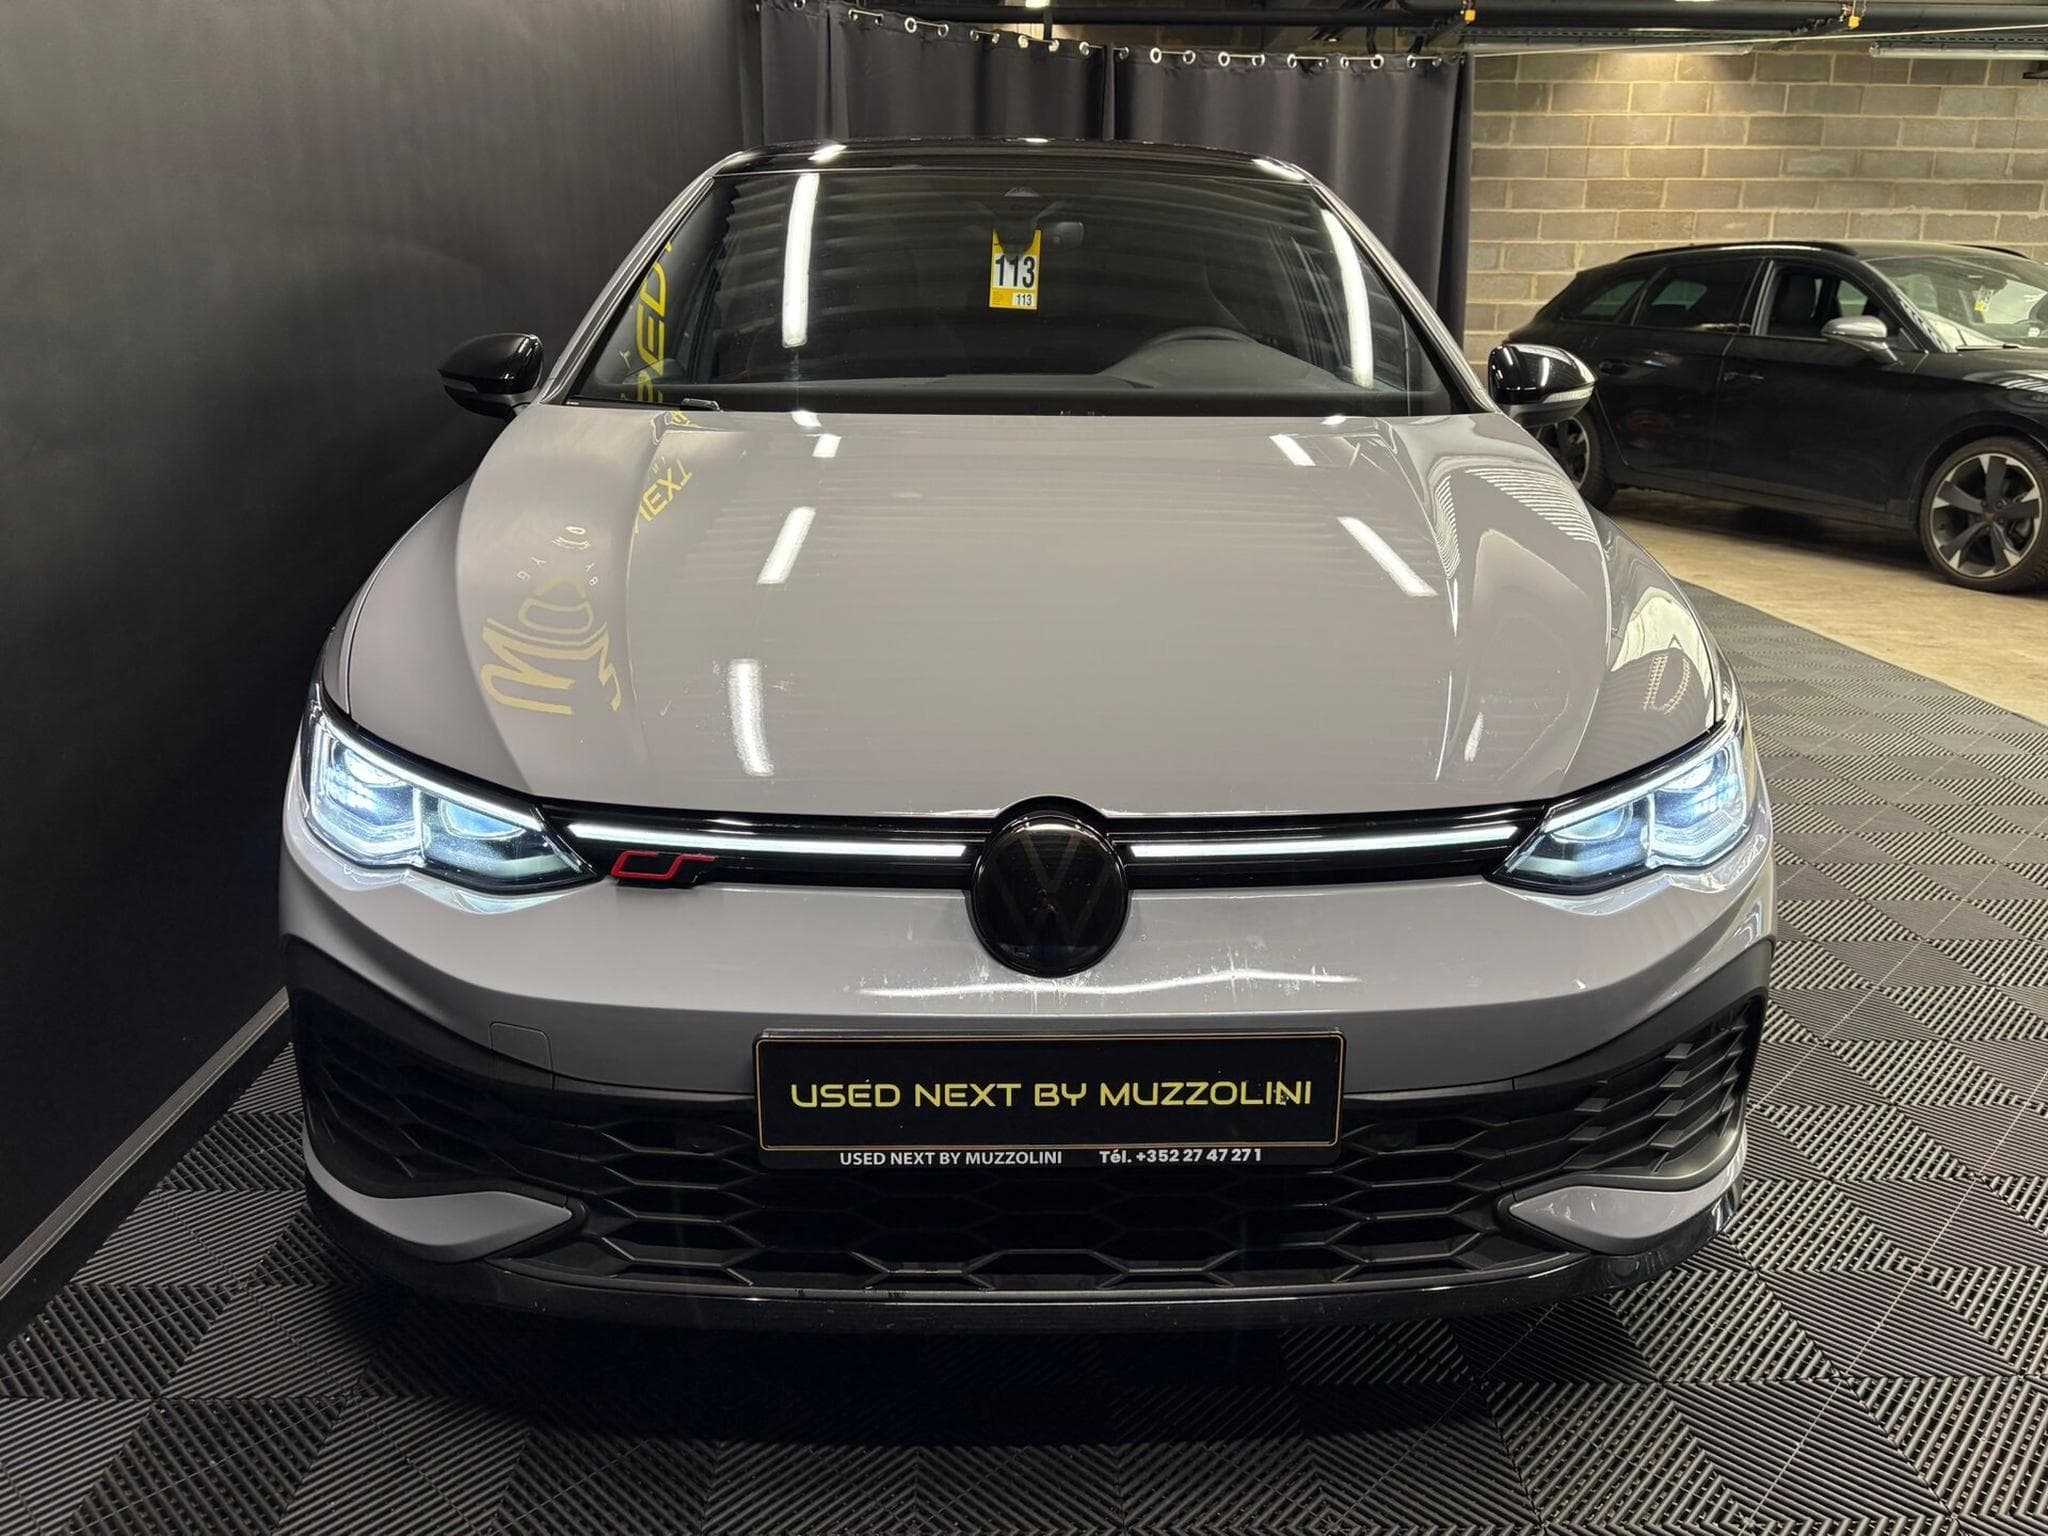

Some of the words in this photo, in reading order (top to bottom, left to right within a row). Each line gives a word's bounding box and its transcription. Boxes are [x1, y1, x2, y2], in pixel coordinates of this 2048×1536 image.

[995, 255, 1035, 288] 113
[1016, 294, 1032, 306] 113
[791, 1083, 901, 1108] USED
[914, 1083, 1022, 1108] NEXT
[1034, 1083, 1087, 1107] BY
[1100, 1080, 1312, 1107] MUZZOLINI
[839, 1152, 886, 1166] USED
[890, 1152, 936, 1165] NEXT
[939, 1152, 961, 1165] BY
[965, 1151, 1062, 1165] MUZZOLINI
[1099, 1149, 1132, 1164] Tél.
[1135, 1149, 1180, 1163] +352
[1182, 1149, 1203, 1162] 27
[1205, 1149, 1228, 1162] 47
